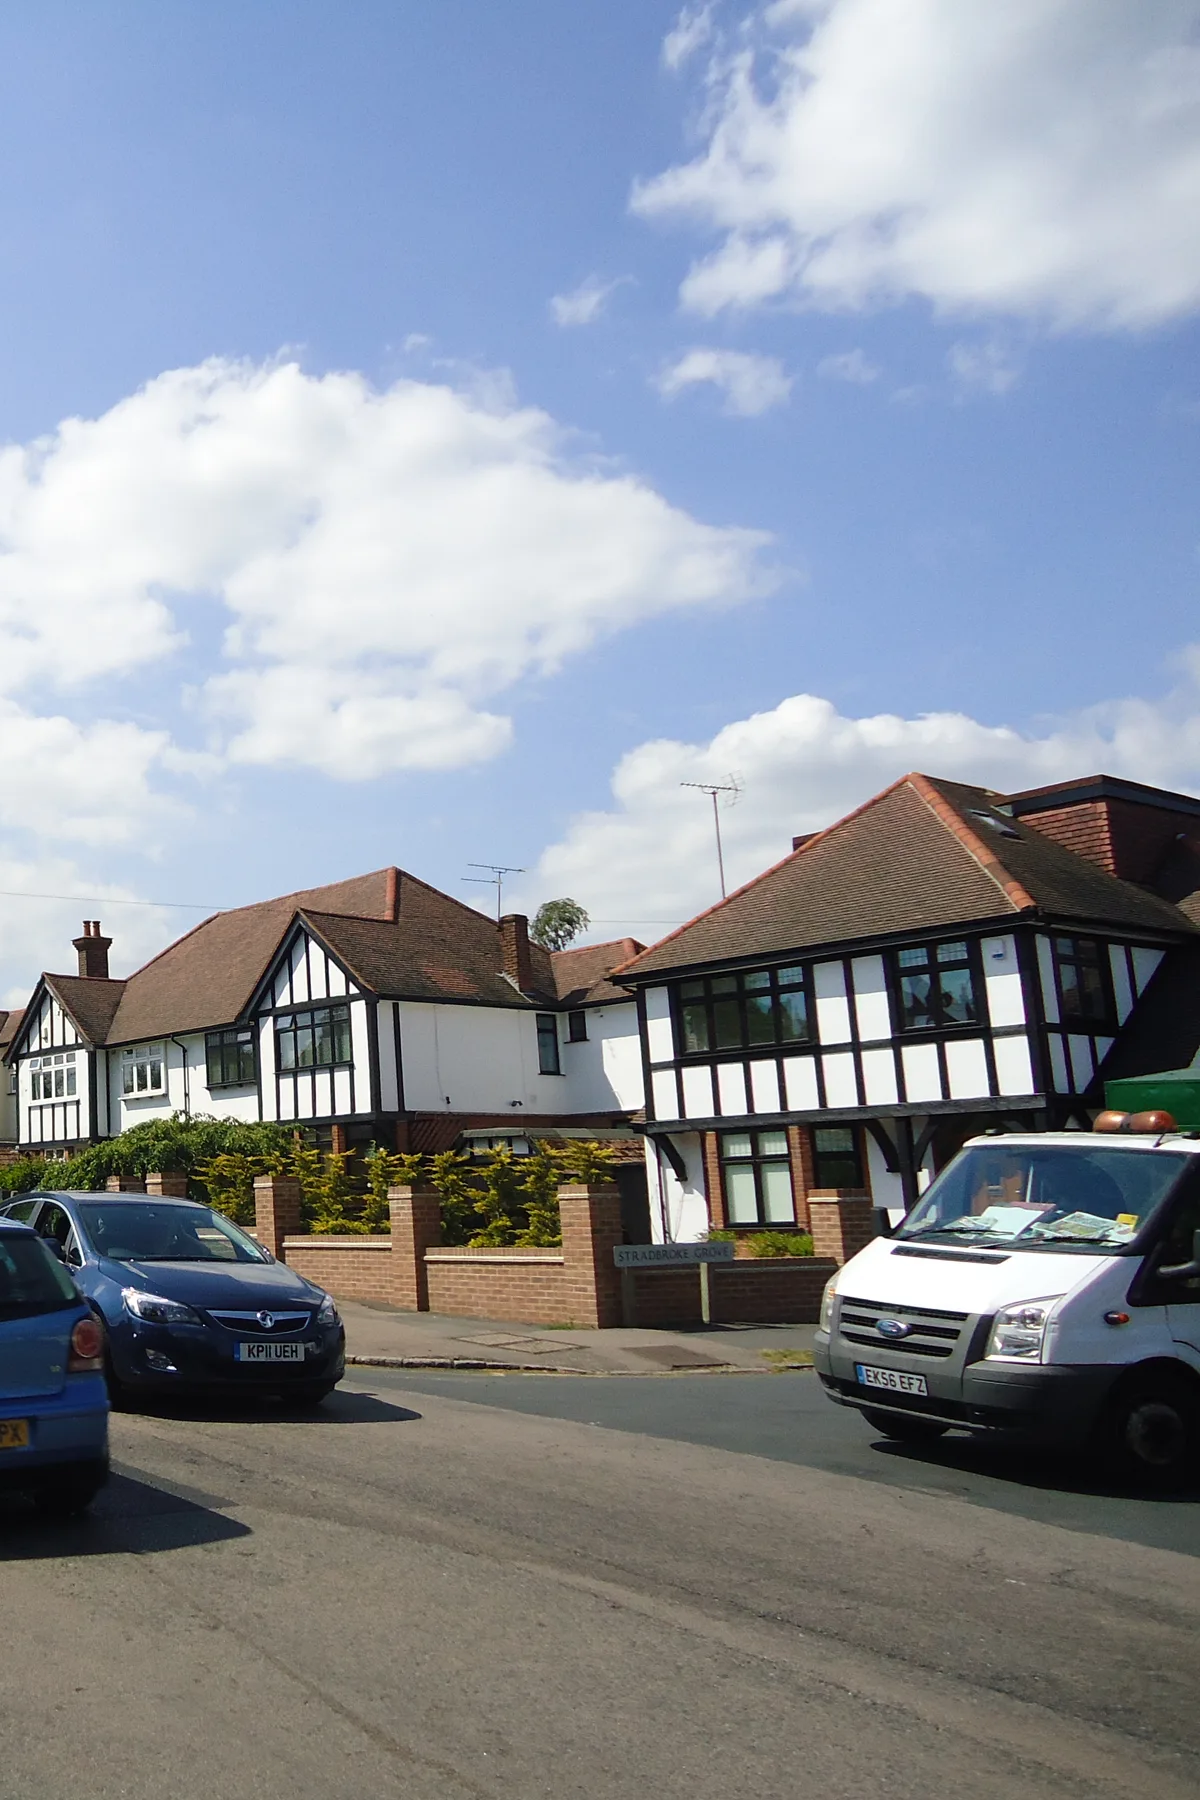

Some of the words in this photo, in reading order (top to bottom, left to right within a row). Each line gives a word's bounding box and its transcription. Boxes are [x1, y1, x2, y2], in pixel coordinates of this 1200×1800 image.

[619, 1248, 688, 1262] STRADBROKE
[694, 1246, 729, 1258] GROVE
[247, 1344, 272, 1358] KP11
[274, 1344, 298, 1358] UEH
[865, 1369, 897, 1388] EK56
[899, 1375, 925, 1393] EFZ
